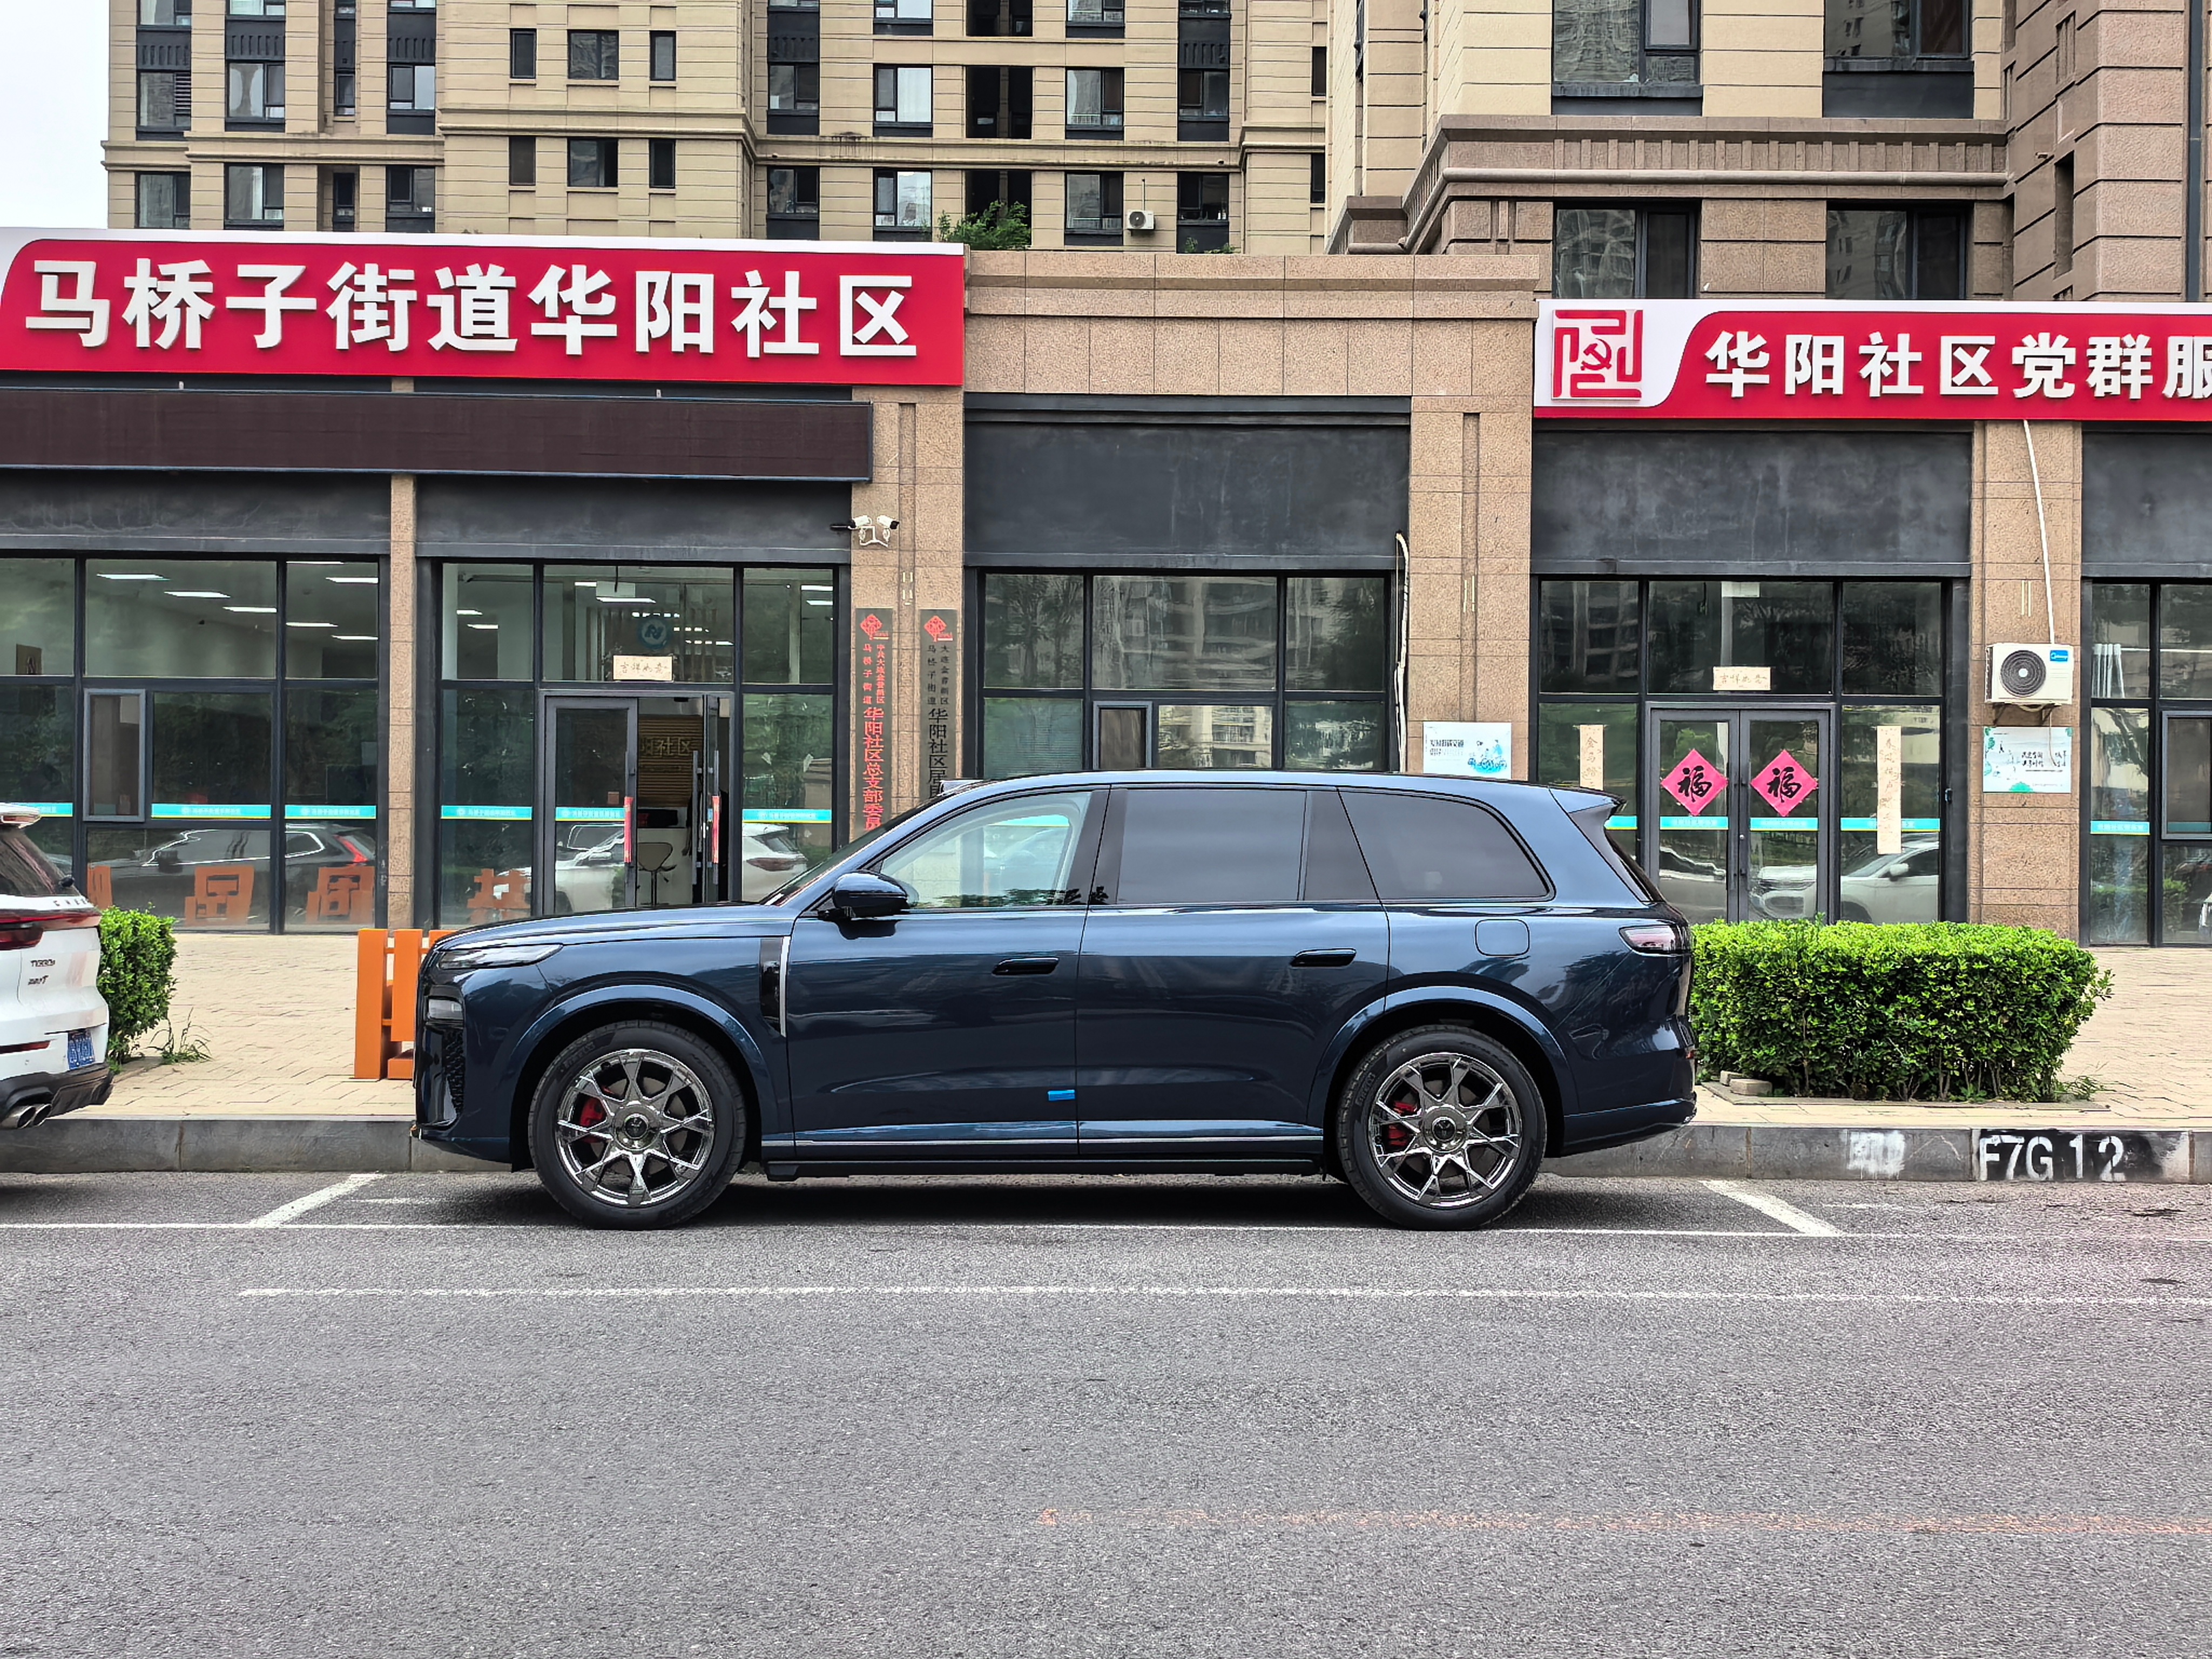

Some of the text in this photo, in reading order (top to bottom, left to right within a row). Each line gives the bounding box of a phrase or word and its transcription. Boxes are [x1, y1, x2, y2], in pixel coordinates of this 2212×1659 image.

[25, 257, 918, 358] 马桥子街道华阳社区
[1705, 329, 2212, 401] 华阳社区党群服
[1677, 765, 1712, 802] 福
[1766, 766, 1802, 803] 福
